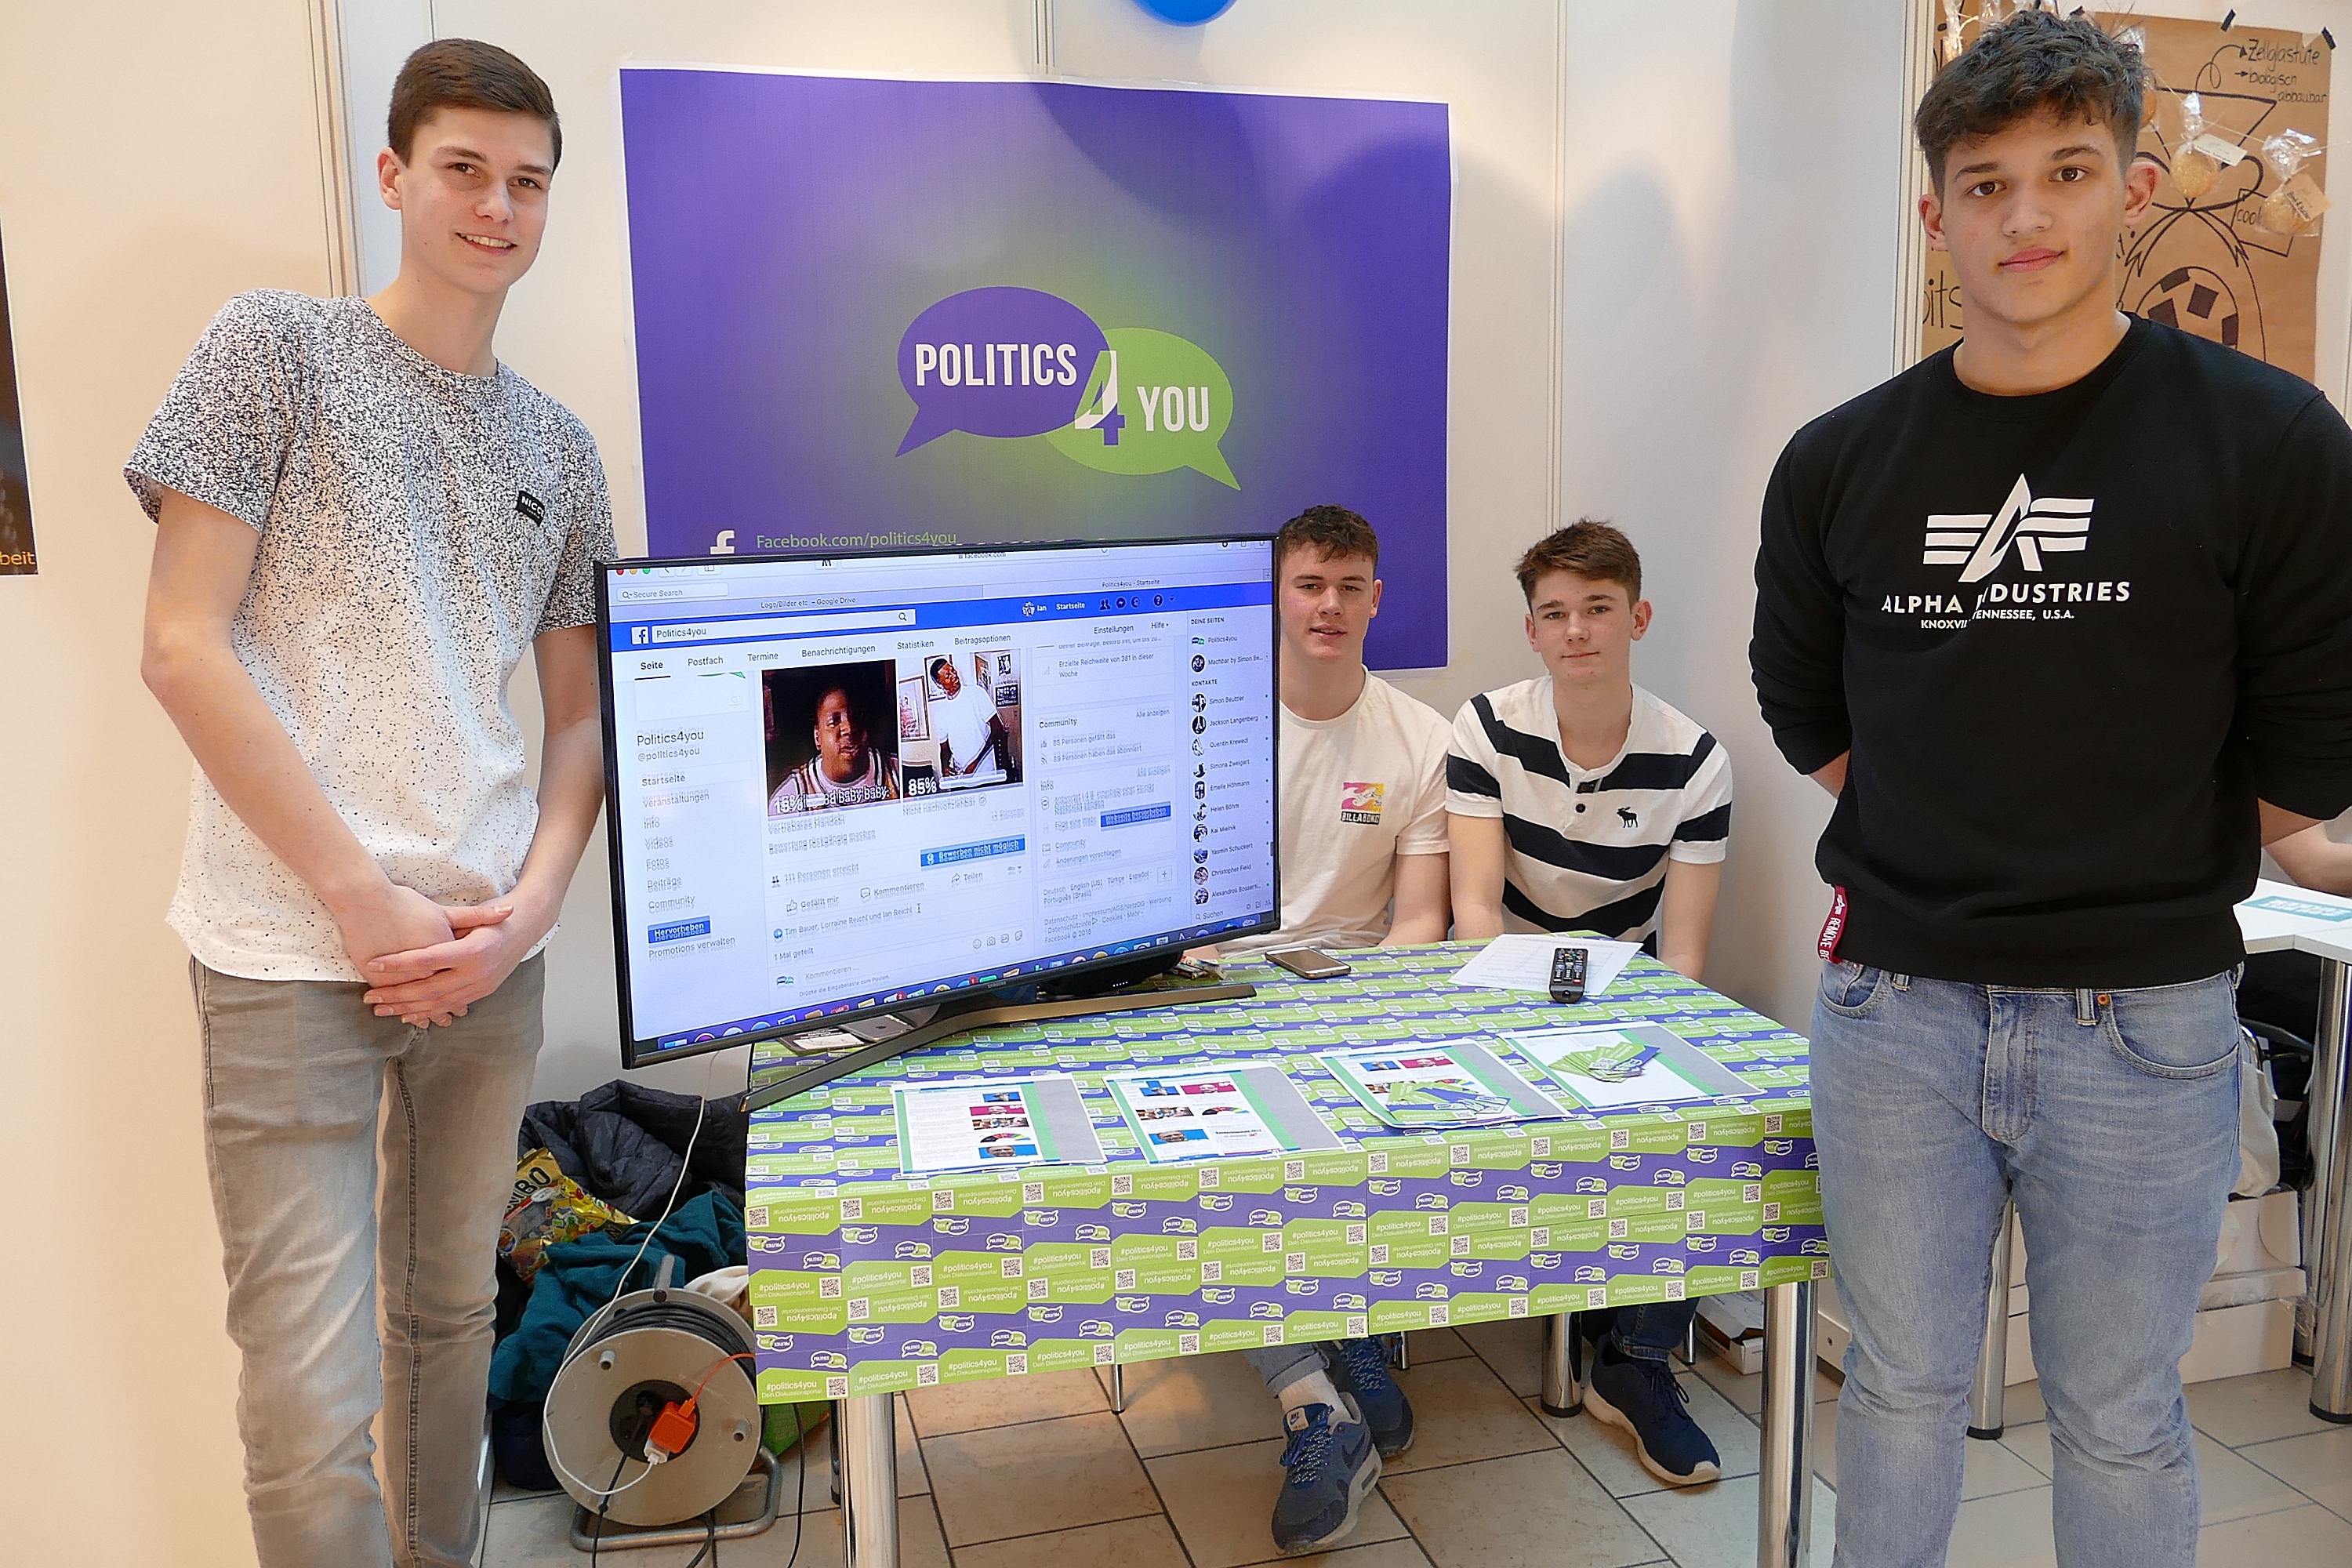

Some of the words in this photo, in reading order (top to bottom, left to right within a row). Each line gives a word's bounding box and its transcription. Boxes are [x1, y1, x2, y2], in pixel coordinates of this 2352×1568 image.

[2237, 207, 2262, 224] cool
[915, 343, 1077, 387] POLITICS
[1074, 350, 1125, 446] 4
[1137, 386, 1210, 432] YOU
[757, 532, 956, 548] Facebook.com/politics4you
[1056, 601, 1085, 611] Startseite
[1882, 595, 1963, 613] ALPHA
[2043, 610, 2074, 619] U.S.A.
[657, 628, 706, 637] Politics4you
[1094, 626, 1134, 634] Einstellungen
[897, 640, 934, 650] Statistiken
[954, 633, 1011, 645] Beitragsoptionen
[748, 652, 779, 661] Termine
[802, 645, 876, 658] Benachrichtigungen
[641, 661, 663, 670] Seite
[688, 656, 723, 666] Postfach
[1039, 718, 1077, 728] Community
[637, 731, 704, 746] Politics4you
[637, 747, 700, 762] @politics4you
[642, 775, 685, 786] Startseite
[908, 777, 937, 796] 85%
[643, 793, 710, 808] Veranstaltungen
[1342, 812, 1379, 823] BILLABONG
[645, 836, 673, 851] Videos
[646, 858, 670, 872] Fotos
[964, 872, 983, 881] Teilen
[647, 877, 682, 892] Beiträge
[874, 881, 924, 897] Kommentieren
[648, 895, 695, 912] Community
[800, 898, 825, 909] Gefällt
[827, 896, 839, 905] mir
[799, 924, 818, 933] Bauer,
[821, 919, 847, 931] Lorraine
[869, 913, 881, 921] und
[894, 907, 912, 916] Reichl
[654, 922, 705, 941] Hervorheben
[1820, 917, 1841, 948] REMOVE
[648, 943, 695, 958] Promotions
[697, 937, 735, 950] verwalten
[793, 948, 814, 959] geteilt
[805, 965, 851, 979] Kommentieren
[1770, 1180, 1809, 1190] #politics4you
[1693, 1188, 1735, 1199] #politics4you
[1616, 1195, 1658, 1206] #politics4you
[1537, 1203, 1581, 1215] #politics4you
[1457, 1211, 1501, 1223] #politics4you
[1377, 1220, 1421, 1232] #politics4you
[1293, 1229, 1338, 1240] #politics4you
[1208, 1237, 1254, 1249] #politics4you
[1121, 1244, 1168, 1257] #politics4you
[1034, 1253, 1081, 1265] #politics4you
[943, 1261, 993, 1274] #politics4you
[1766, 1265, 1804, 1276] #politics4you
[852, 1270, 902, 1284] #politics4you
[1693, 1275, 1733, 1286] #politics4you
[760, 1281, 810, 1293] #politics4you
[1615, 1284, 1657, 1296] #politics4you
[1537, 1293, 1580, 1305] #politics4you
[1457, 1301, 1501, 1314] #politics4you
[1377, 1309, 1421, 1321] #politics4you
[1293, 1320, 1338, 1333] #politics4you
[1209, 1329, 1254, 1341] #politics4you
[1125, 1338, 1171, 1352] #politics4you
[1037, 1348, 1085, 1361] #politics4you
[949, 1359, 997, 1372] #politics4you
[858, 1370, 908, 1384] #politics4you
[767, 1380, 817, 1392] #politics4you
